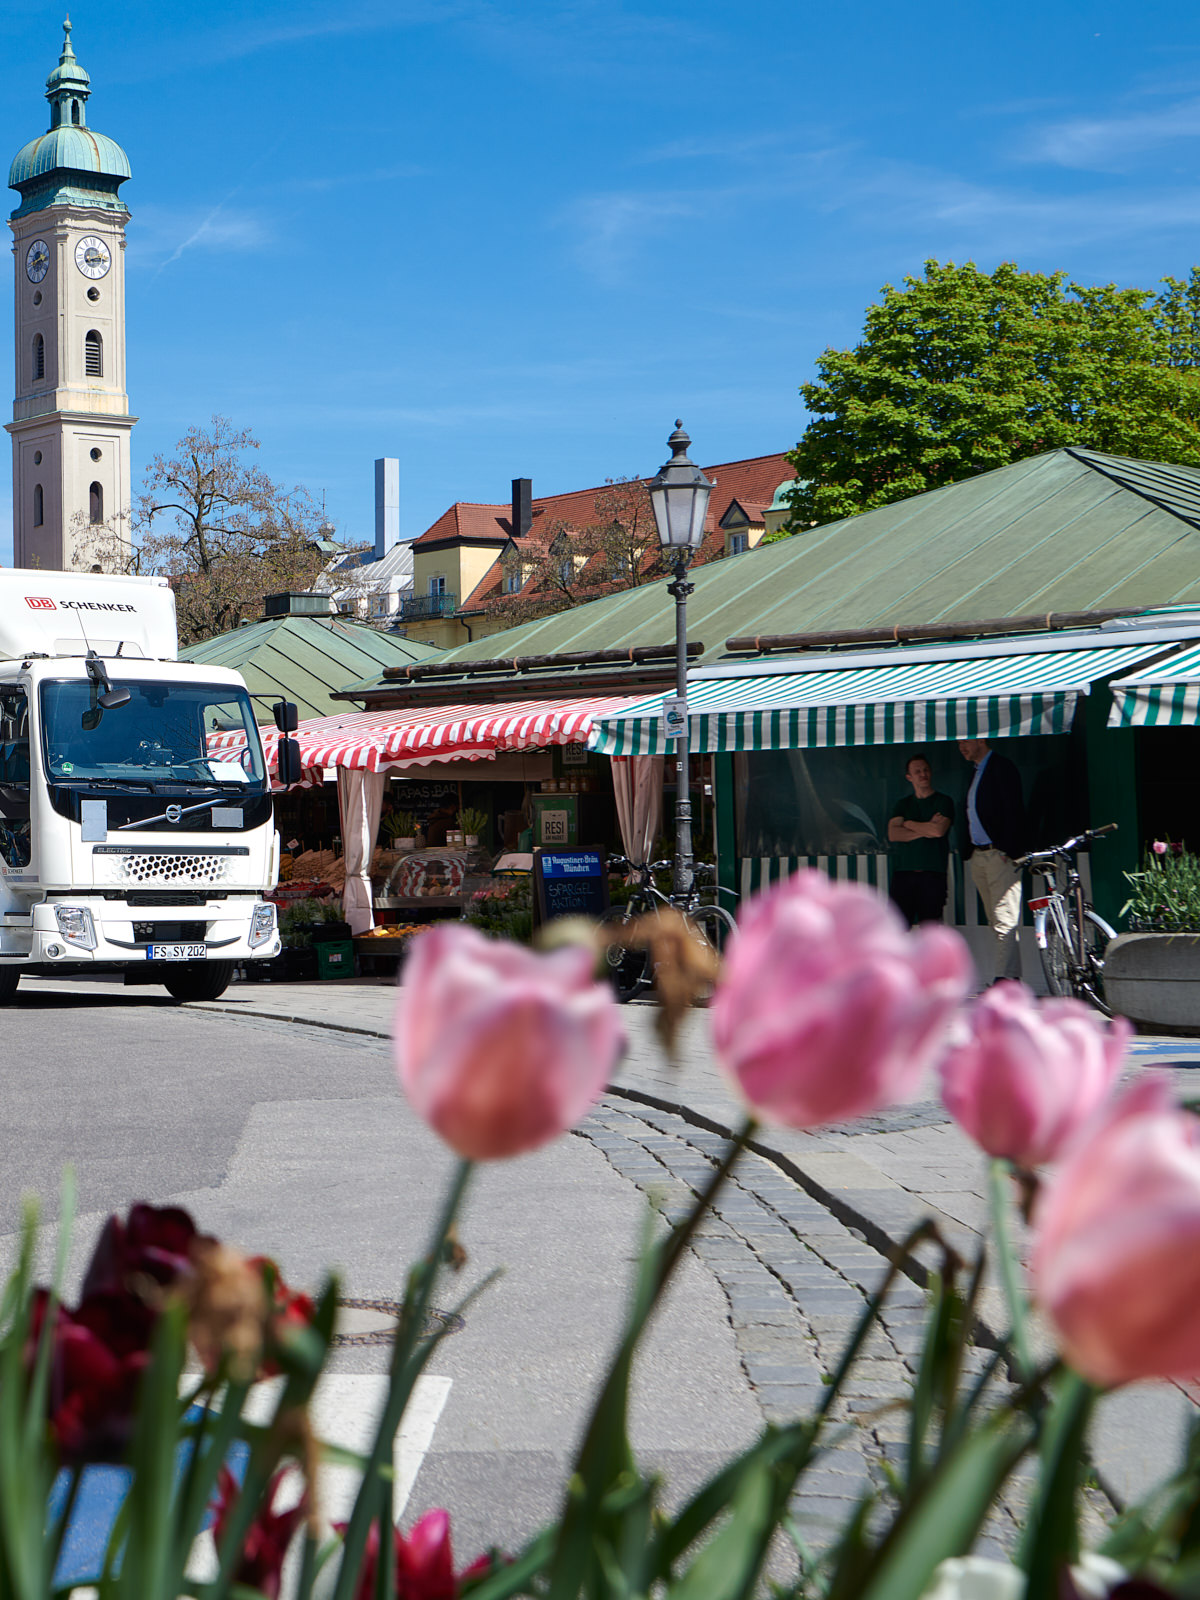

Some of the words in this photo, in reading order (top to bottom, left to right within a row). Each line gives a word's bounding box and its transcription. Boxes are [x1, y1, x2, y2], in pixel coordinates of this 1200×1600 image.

[27, 598, 54, 608] DB
[60, 600, 137, 612] SCHENKER
[545, 821, 564, 834] RESI
[549, 882, 595, 897] SPARGEL
[154, 947, 167, 957] FS
[174, 946, 186, 957] SY
[187, 945, 205, 957] 202
